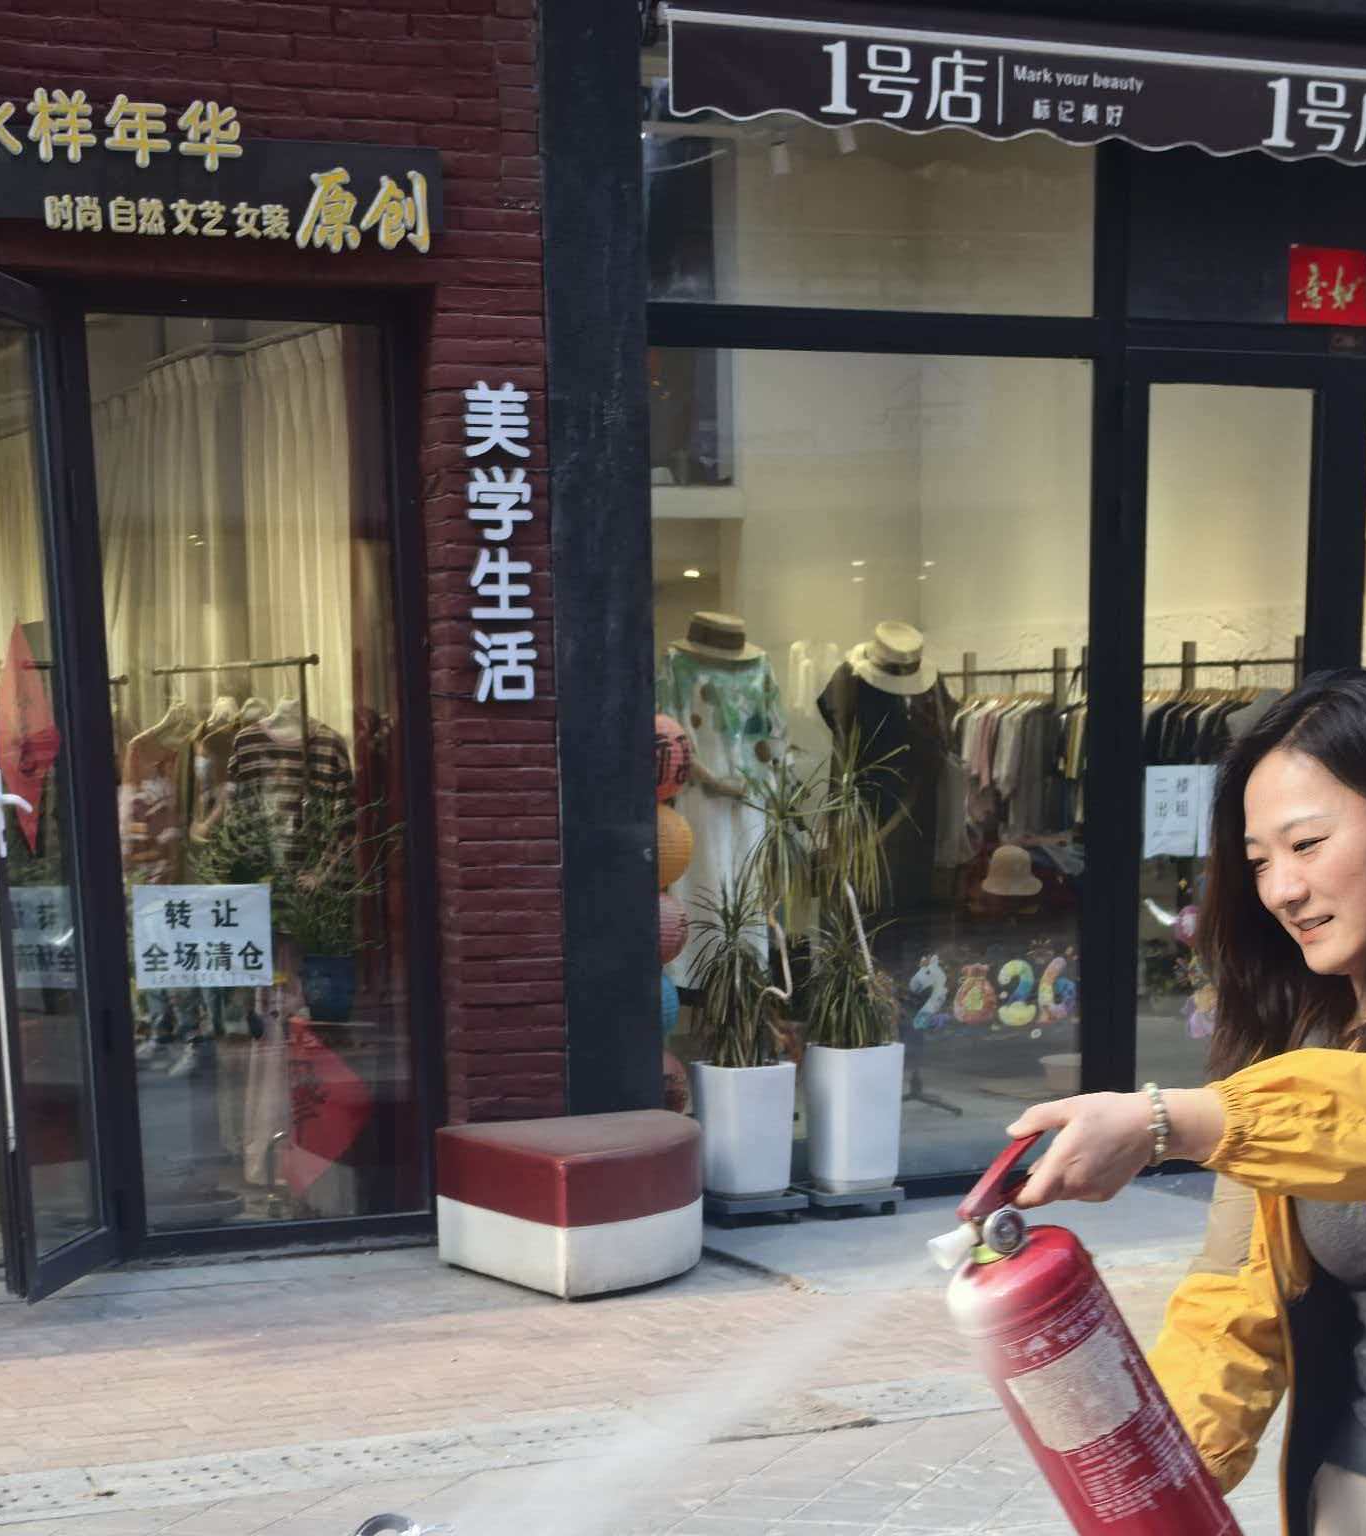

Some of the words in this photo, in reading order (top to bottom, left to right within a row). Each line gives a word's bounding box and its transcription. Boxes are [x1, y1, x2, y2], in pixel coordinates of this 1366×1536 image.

[820, 40, 988, 124] 1号店
[1014, 64, 1053, 84] Mark
[1055, 72, 1090, 88] your
[1092, 72, 1145, 94] beauty
[1032, 98, 1124, 127] 标记美好
[295, 166, 431, 253] 原创
[463, 380, 538, 703] 美学生活
[164, 899, 239, 930] 转让
[142, 941, 264, 972] 全场清仓
